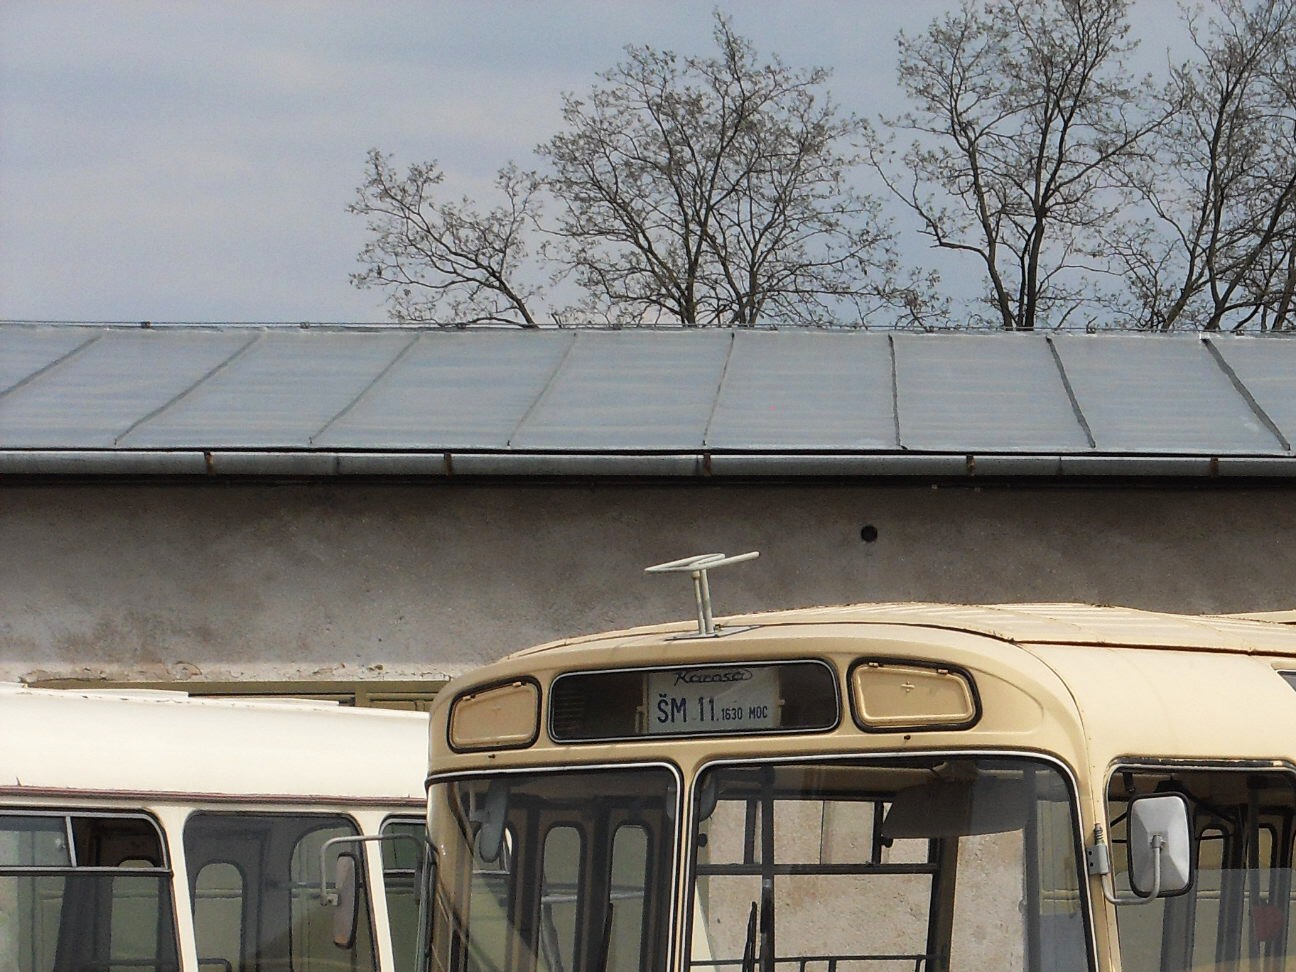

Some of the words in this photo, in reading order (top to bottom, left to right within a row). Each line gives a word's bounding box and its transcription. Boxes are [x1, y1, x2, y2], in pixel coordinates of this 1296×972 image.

[673, 669, 753, 687] Karosa
[657, 693, 687, 723] ŠM
[721, 707, 743, 720] 1630
[748, 705, 768, 719] MOC
